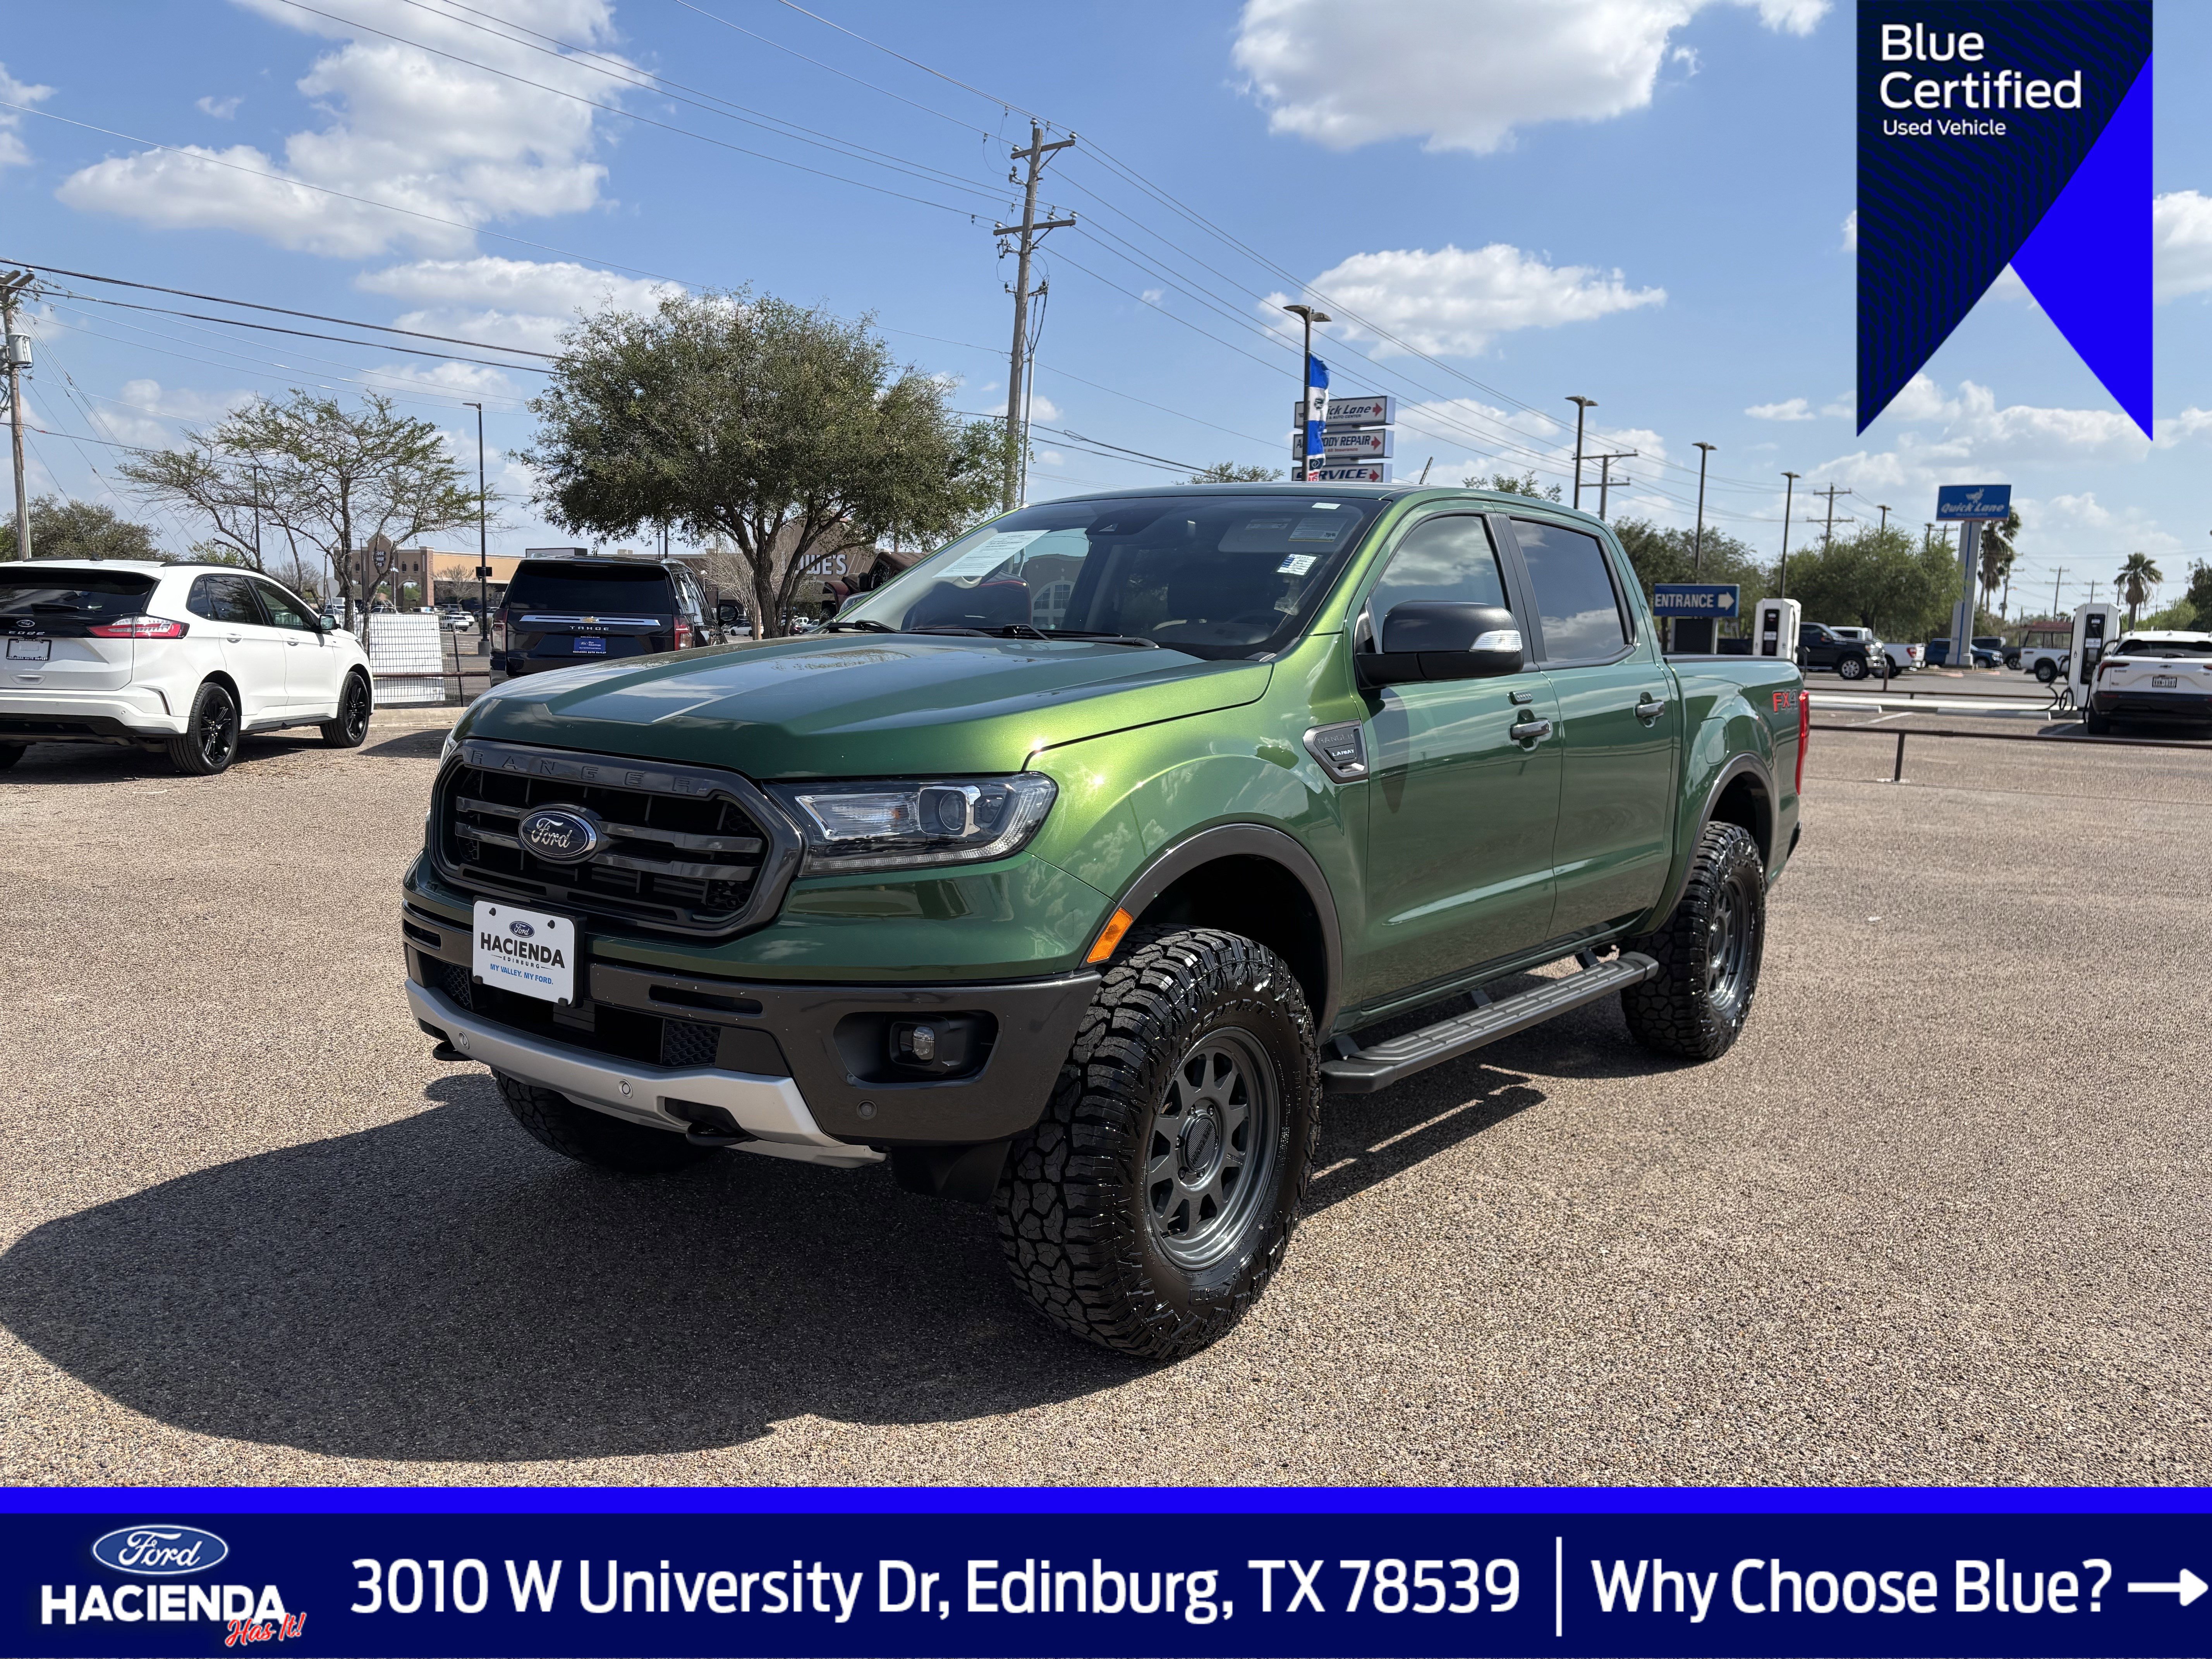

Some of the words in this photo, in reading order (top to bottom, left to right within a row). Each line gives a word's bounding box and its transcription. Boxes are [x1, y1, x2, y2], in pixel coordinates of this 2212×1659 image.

[1343, 405, 1372, 414] Lane
[1340, 436, 1371, 446] REPAIR
[1296, 469, 1369, 479] SRVICE
[1941, 502, 1973, 514] Quick
[1974, 502, 2005, 512] Lane
[1655, 593, 1715, 608] ENTRANCE
[1772, 690, 1798, 713] FX4
[1318, 734, 1353, 744] RANGER
[471, 750, 692, 793] RANGER
[531, 818, 573, 848] Ford
[514, 923, 529, 936] Ford
[481, 932, 565, 969] HACIENDA
[503, 956, 539, 969] EDINBURG
[490, 963, 500, 971] MY
[501, 966, 522, 977] VALLEY.
[524, 972, 534, 980] MY
[535, 975, 553, 985] FORD.
